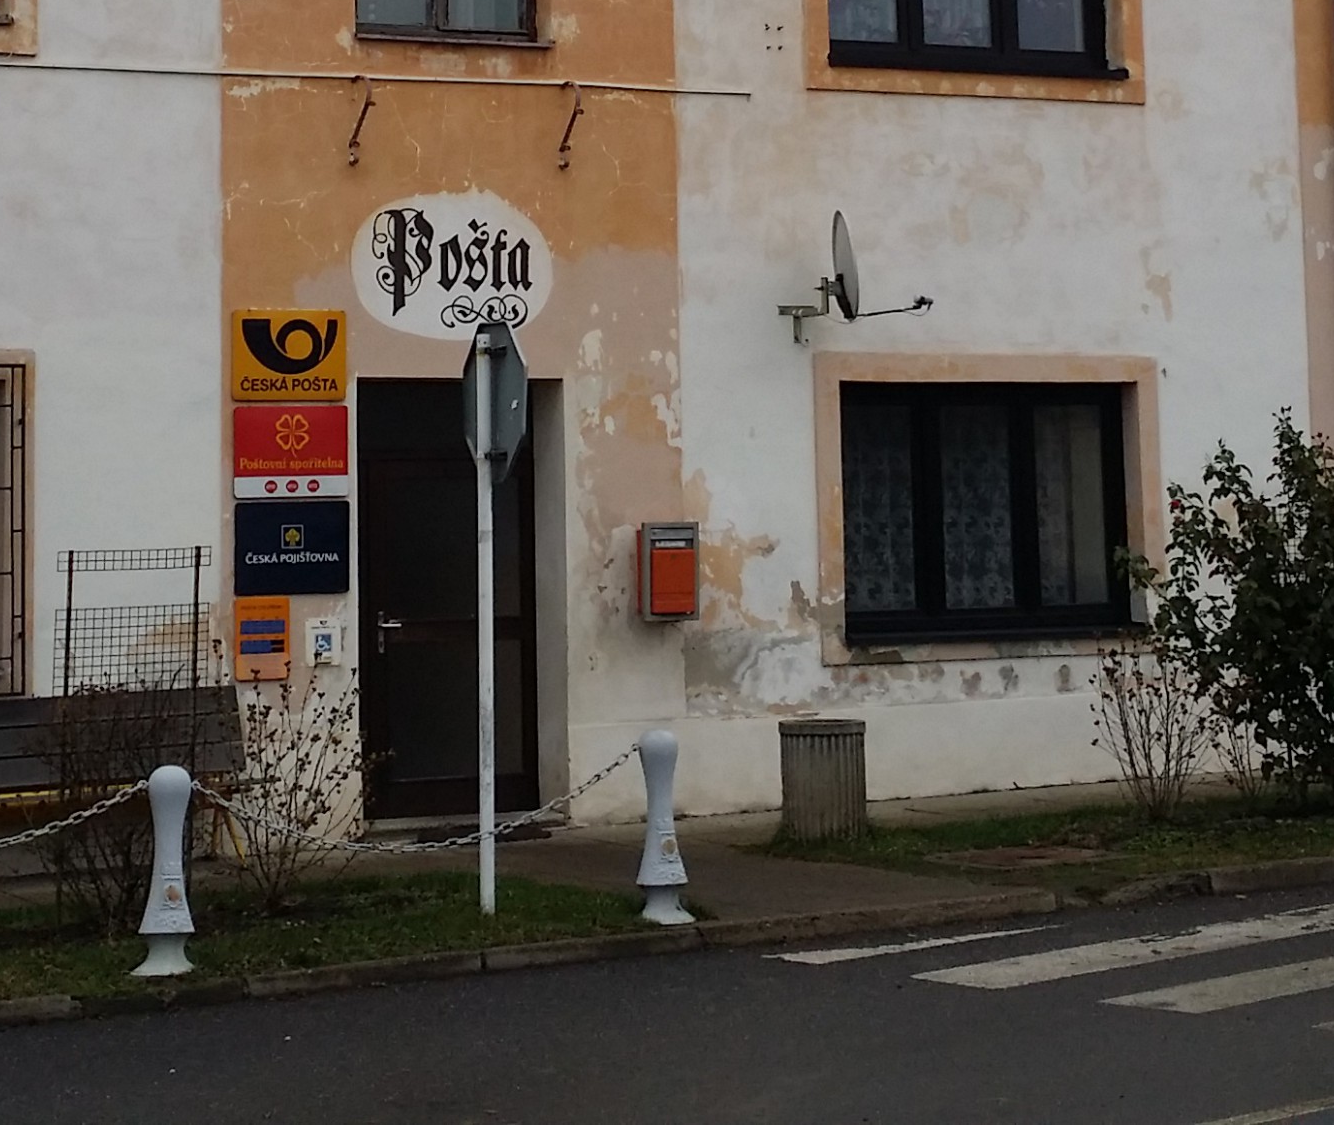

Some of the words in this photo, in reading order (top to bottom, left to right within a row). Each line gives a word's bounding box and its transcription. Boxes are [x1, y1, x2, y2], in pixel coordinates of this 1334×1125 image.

[372, 208, 533, 316] Pošta
[240, 376, 288, 392] ČESKÁ
[291, 376, 338, 392] POŠTA
[239, 457, 287, 470] Poštovní
[290, 456, 344, 472] spořitelna
[245, 552, 278, 565] ČESKÁ
[280, 551, 339, 564] POJIŠŤOVNA
